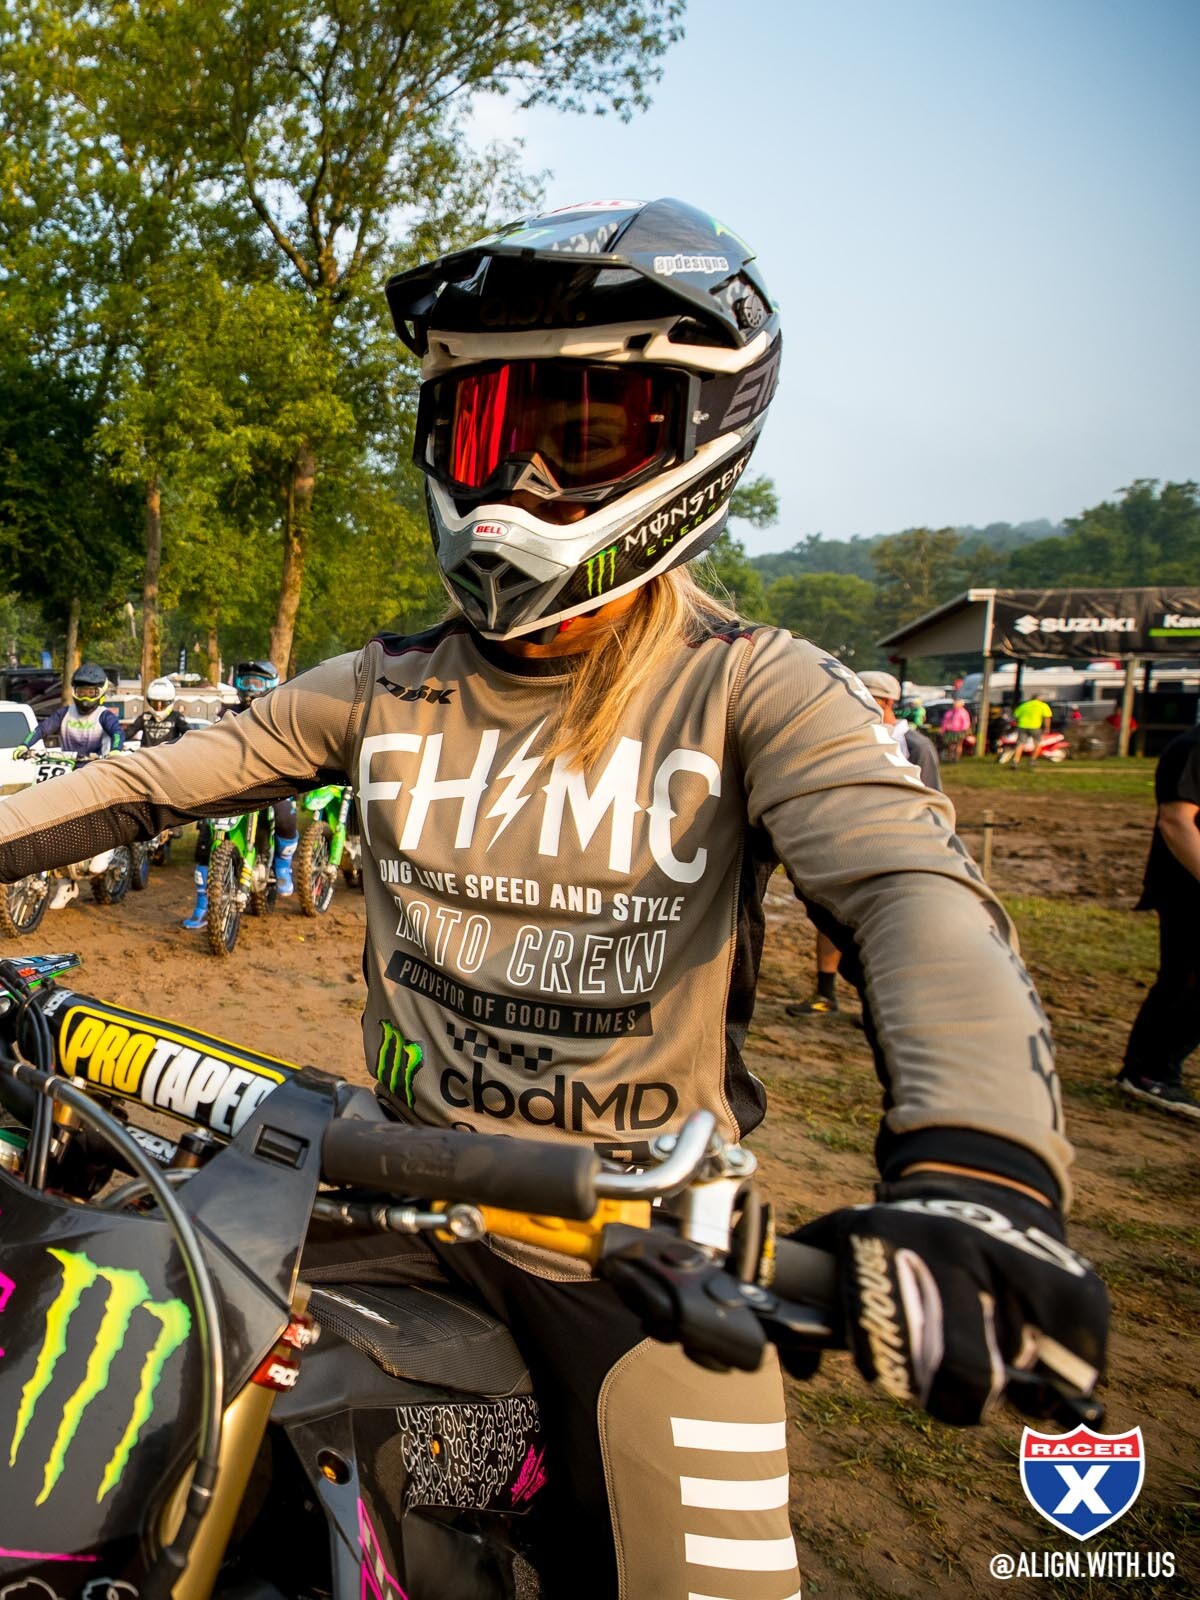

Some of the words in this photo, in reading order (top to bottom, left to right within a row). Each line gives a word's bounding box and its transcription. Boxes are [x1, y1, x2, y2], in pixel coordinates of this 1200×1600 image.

[475, 525, 503, 535] BELL
[1039, 617, 1137, 633] SUZUKI
[380, 859, 412, 884] ONG
[415, 868, 459, 895] LIVE
[464, 873, 541, 906] SPEED
[549, 883, 602, 915] AND
[611, 892, 685, 923] STYLE
[506, 924, 667, 995] CREW
[399, 960, 465, 1012] PURVEYOR
[472, 994, 496, 1020] OF
[505, 1002, 561, 1031] GOOD
[572, 1009, 637, 1034] TIMES
[438, 1066, 678, 1132] cbdMD
